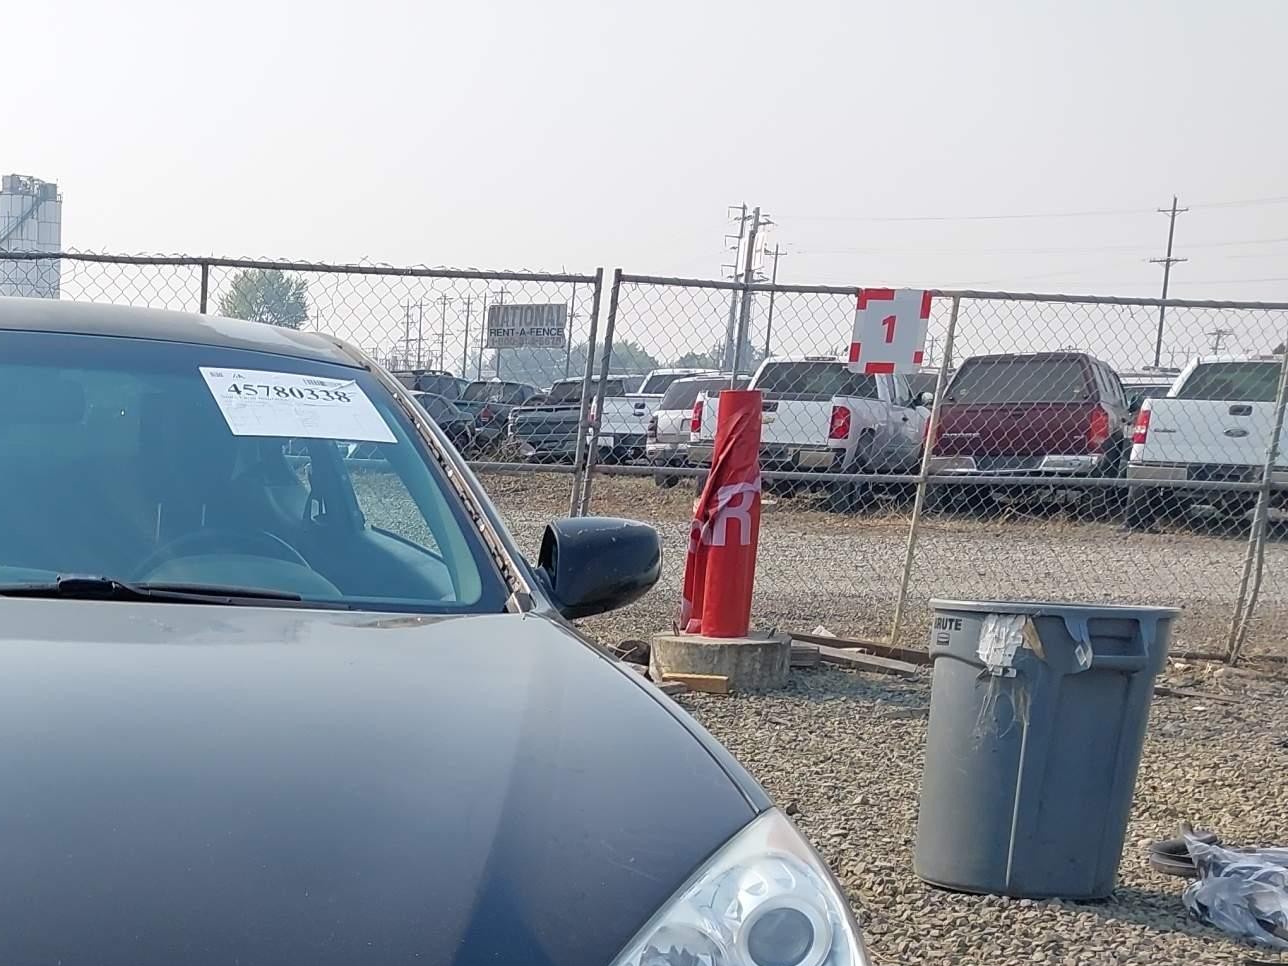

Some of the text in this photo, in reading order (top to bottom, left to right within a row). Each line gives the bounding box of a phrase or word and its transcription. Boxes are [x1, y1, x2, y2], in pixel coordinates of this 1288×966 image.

[489, 305, 564, 327] NATIONAL
[489, 327, 564, 337] RENT-A-FENCE
[882, 315, 896, 344] 1
[227, 382, 352, 404] 45780338
